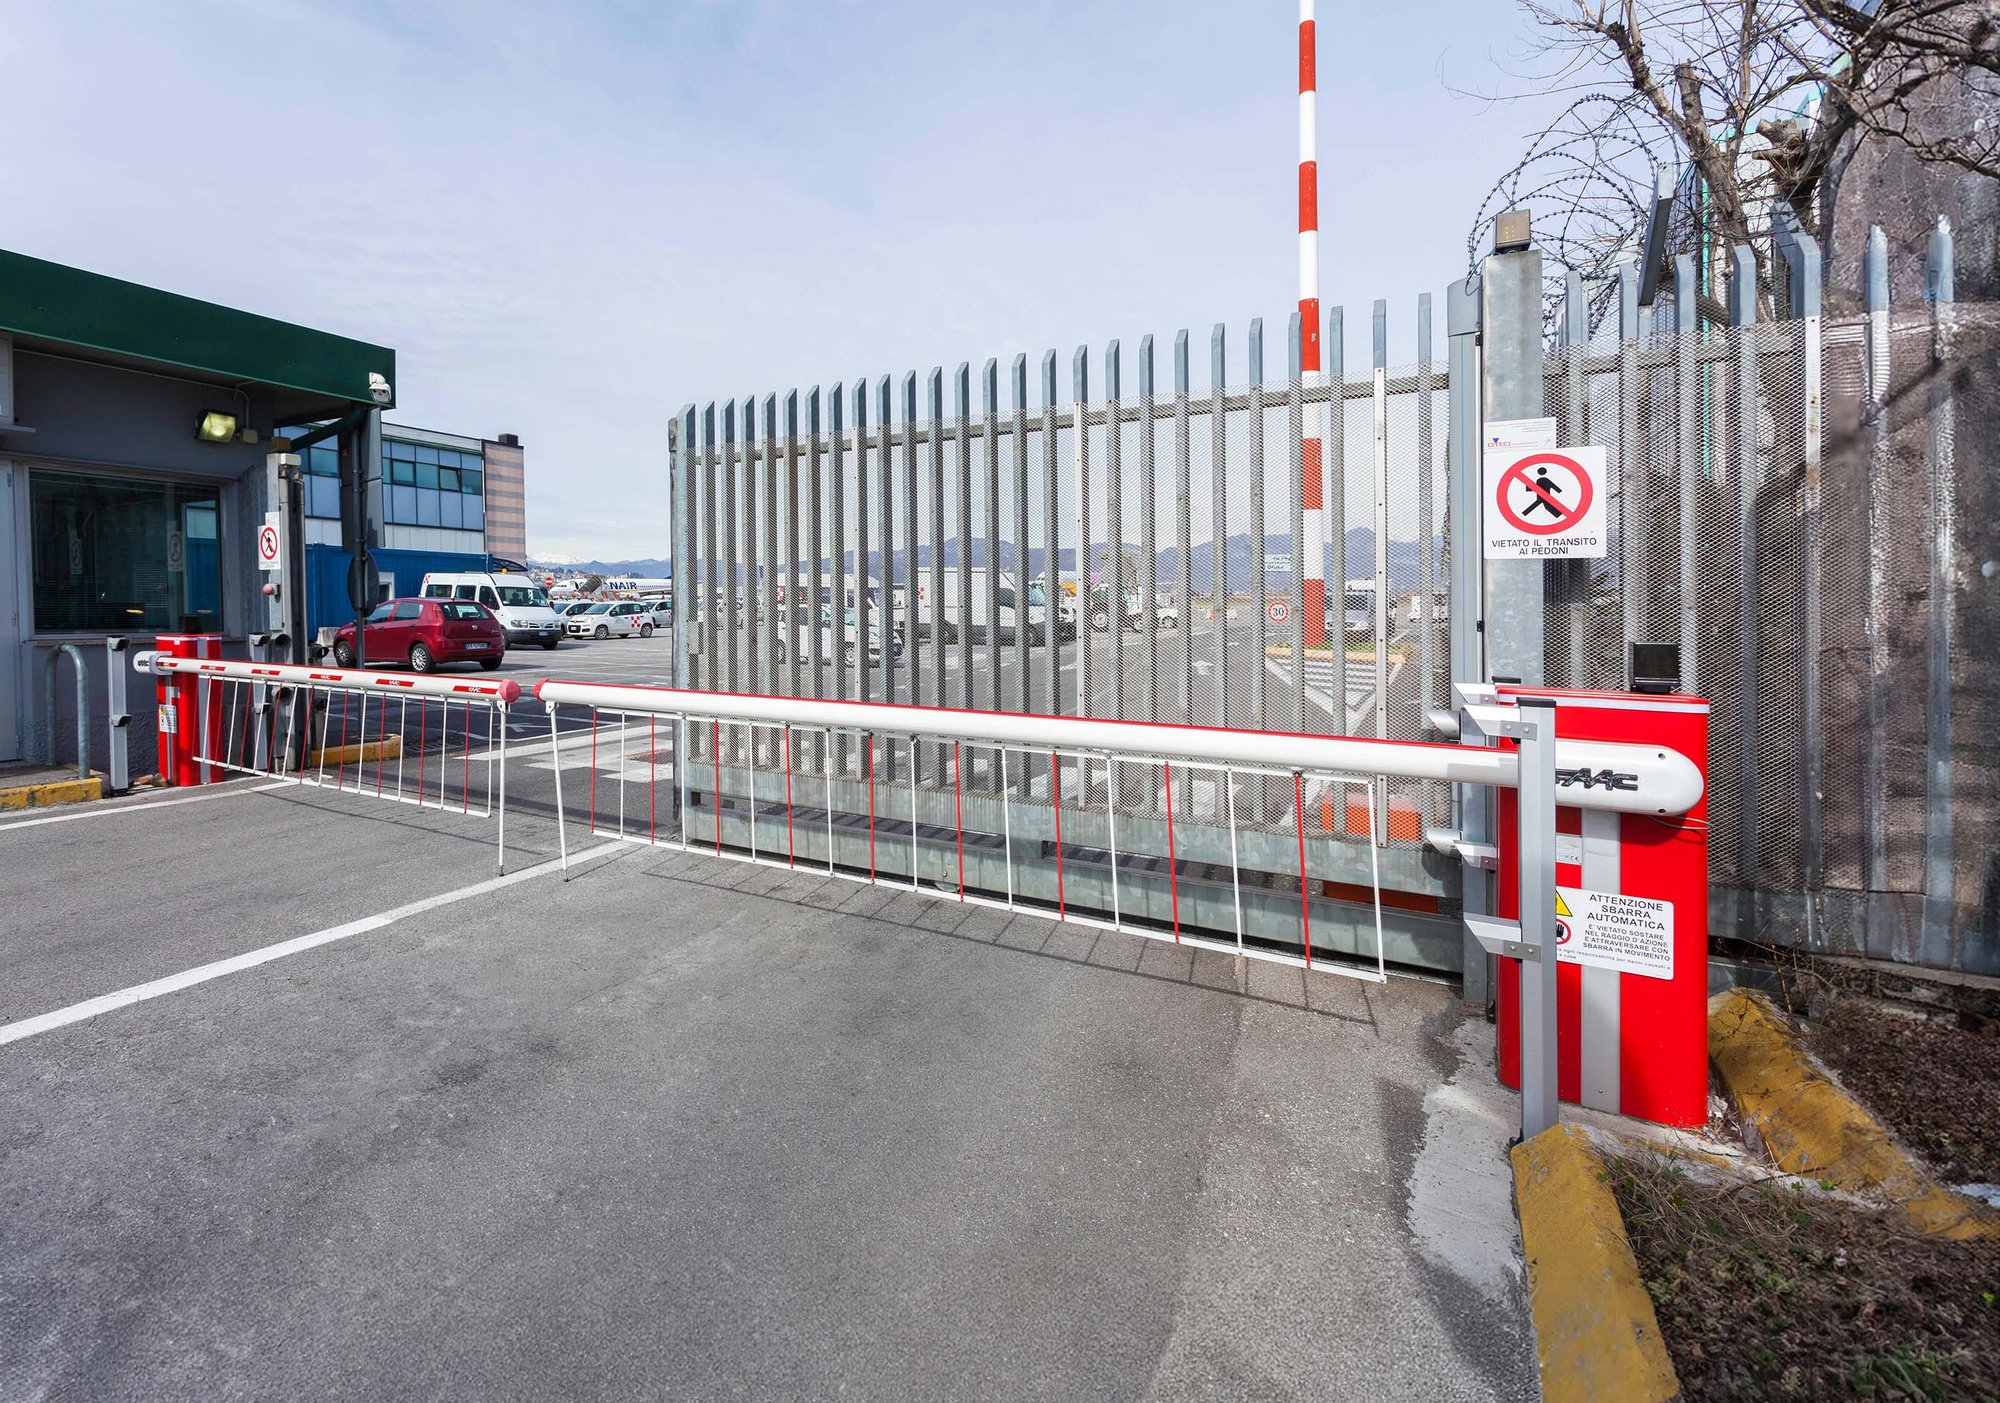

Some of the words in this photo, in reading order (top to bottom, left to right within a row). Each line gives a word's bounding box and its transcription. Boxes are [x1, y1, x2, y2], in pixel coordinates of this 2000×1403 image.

[1492, 540, 1530, 548] VIETATO
[1548, 538, 1597, 546] TRANSITO
[1532, 547, 1568, 555] PEDONI
[604, 582, 637, 590] NAIR
[1272, 607, 1284, 617] 30
[1555, 768, 1638, 791] FAAC
[1589, 894, 1664, 911] ATTENZIONE
[1601, 905, 1651, 919] SBARRA
[1587, 912, 1665, 930] AUTOMATICA
[1597, 925, 1627, 934] VIETATO
[1629, 929, 1664, 940] SOSTARE
[1591, 938, 1650, 951] ATTRAVERSARE
[1601, 932, 1630, 942] RAGGIO
[1632, 936, 1668, 948] D'AZIONE
[1583, 942, 1613, 952] SBARRA
[1624, 949, 1670, 961] MOVIMENTO
